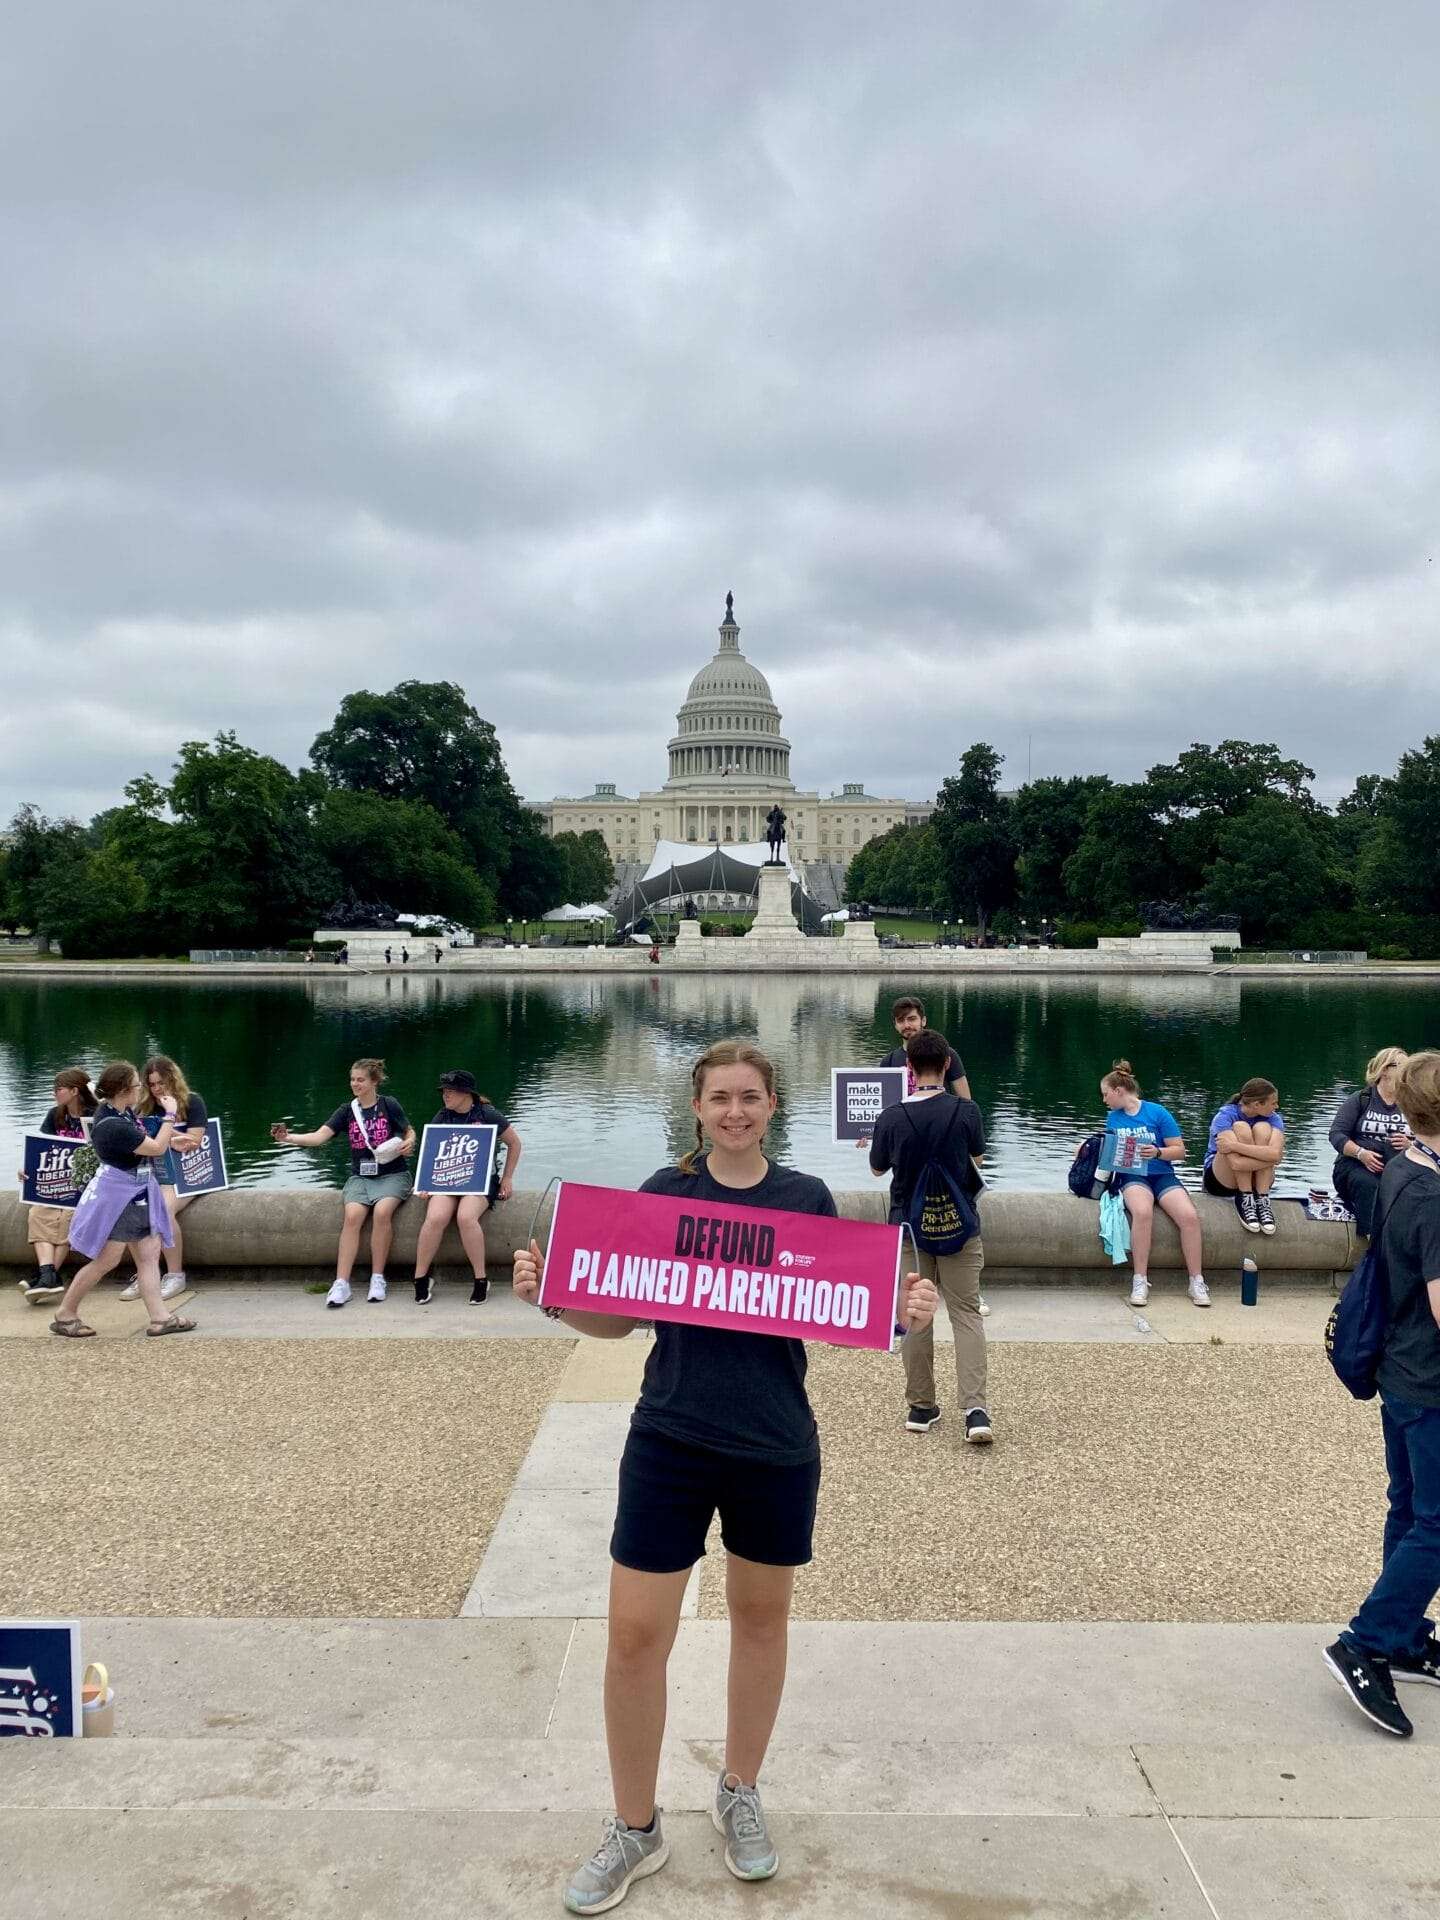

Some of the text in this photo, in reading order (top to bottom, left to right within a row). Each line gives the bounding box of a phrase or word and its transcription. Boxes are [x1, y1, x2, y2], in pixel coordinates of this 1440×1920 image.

[848, 1083, 880, 1095] make
[848, 1097, 880, 1106] more
[434, 1134, 479, 1161] Life
[181, 1149, 211, 1170] LIBERTY
[433, 1154, 477, 1170] LIBERTY
[36, 1169, 72, 1181] LIBERT
[675, 1214, 776, 1268] DEFUND
[568, 1248, 870, 1330] PLANNED PARENTHOOD
[0, 1666, 54, 1738] Lif
